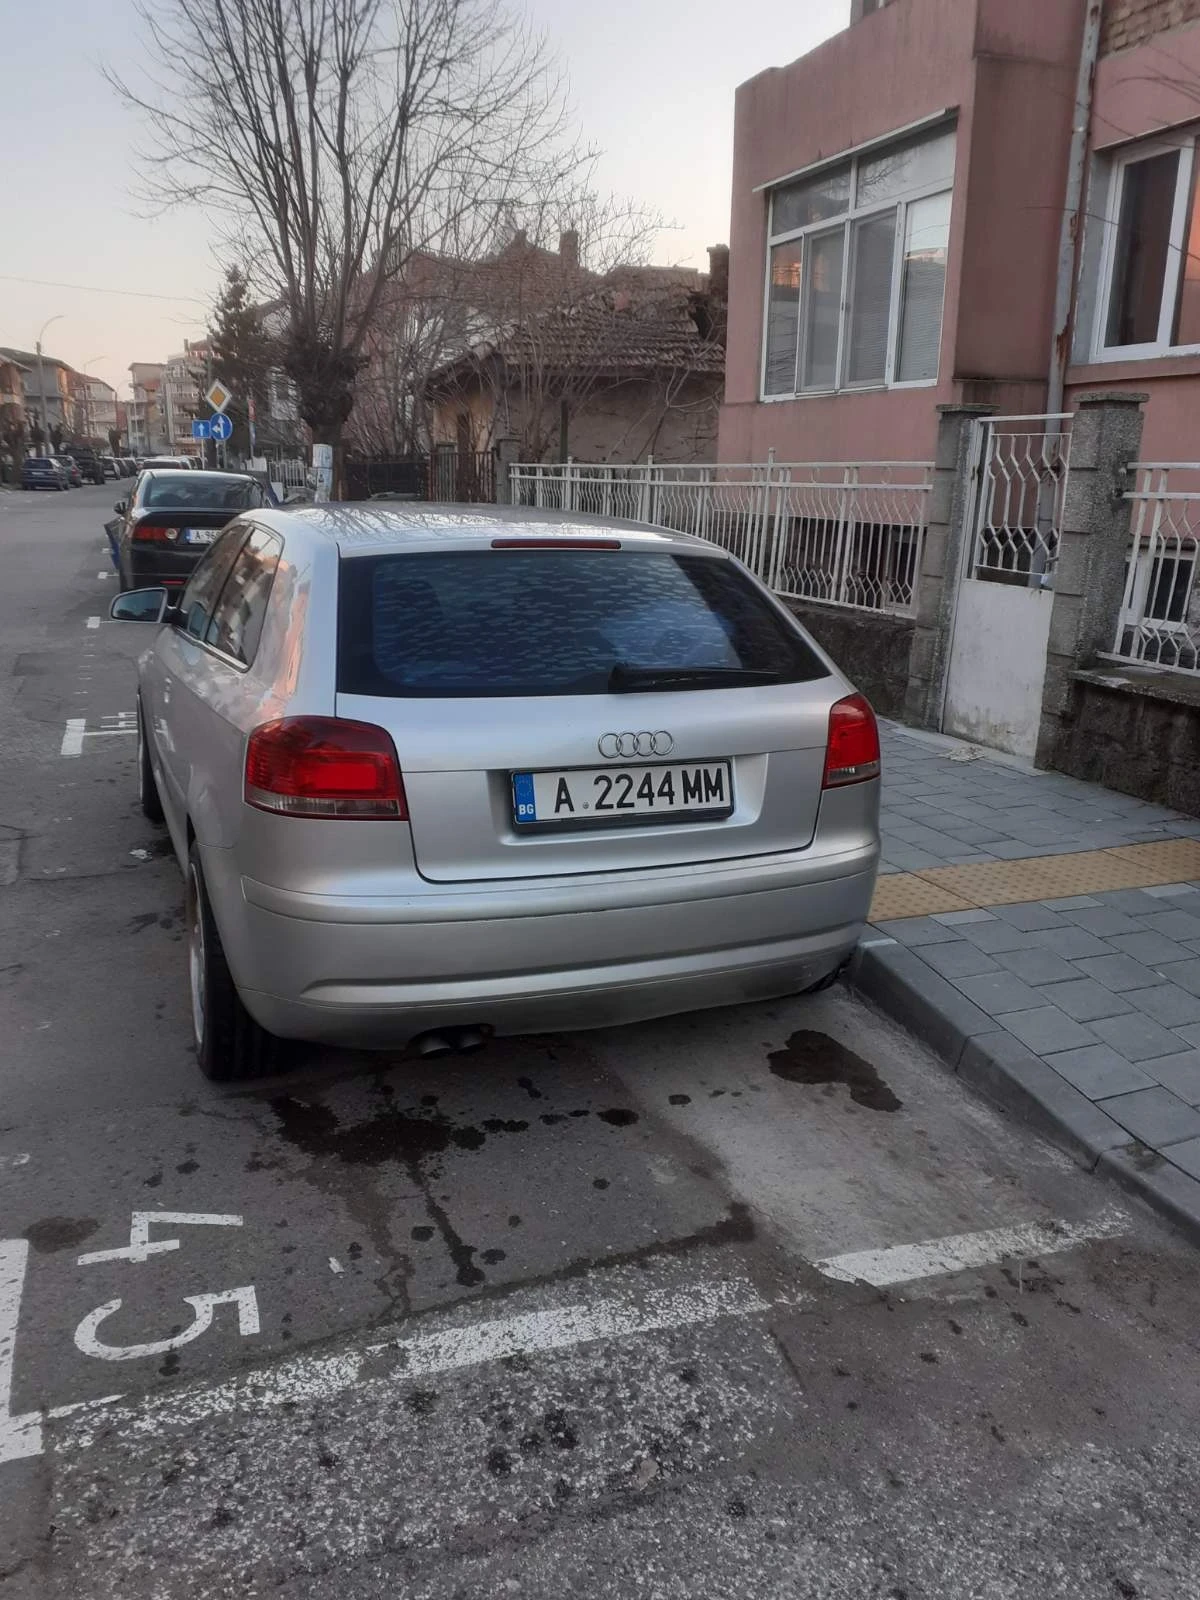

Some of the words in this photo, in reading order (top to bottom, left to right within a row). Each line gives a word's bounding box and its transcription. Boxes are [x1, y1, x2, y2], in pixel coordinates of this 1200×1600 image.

[554, 777, 574, 813] A
[593, 770, 675, 810] 2244
[681, 768, 724, 804] MM
[518, 801, 534, 815] BG
